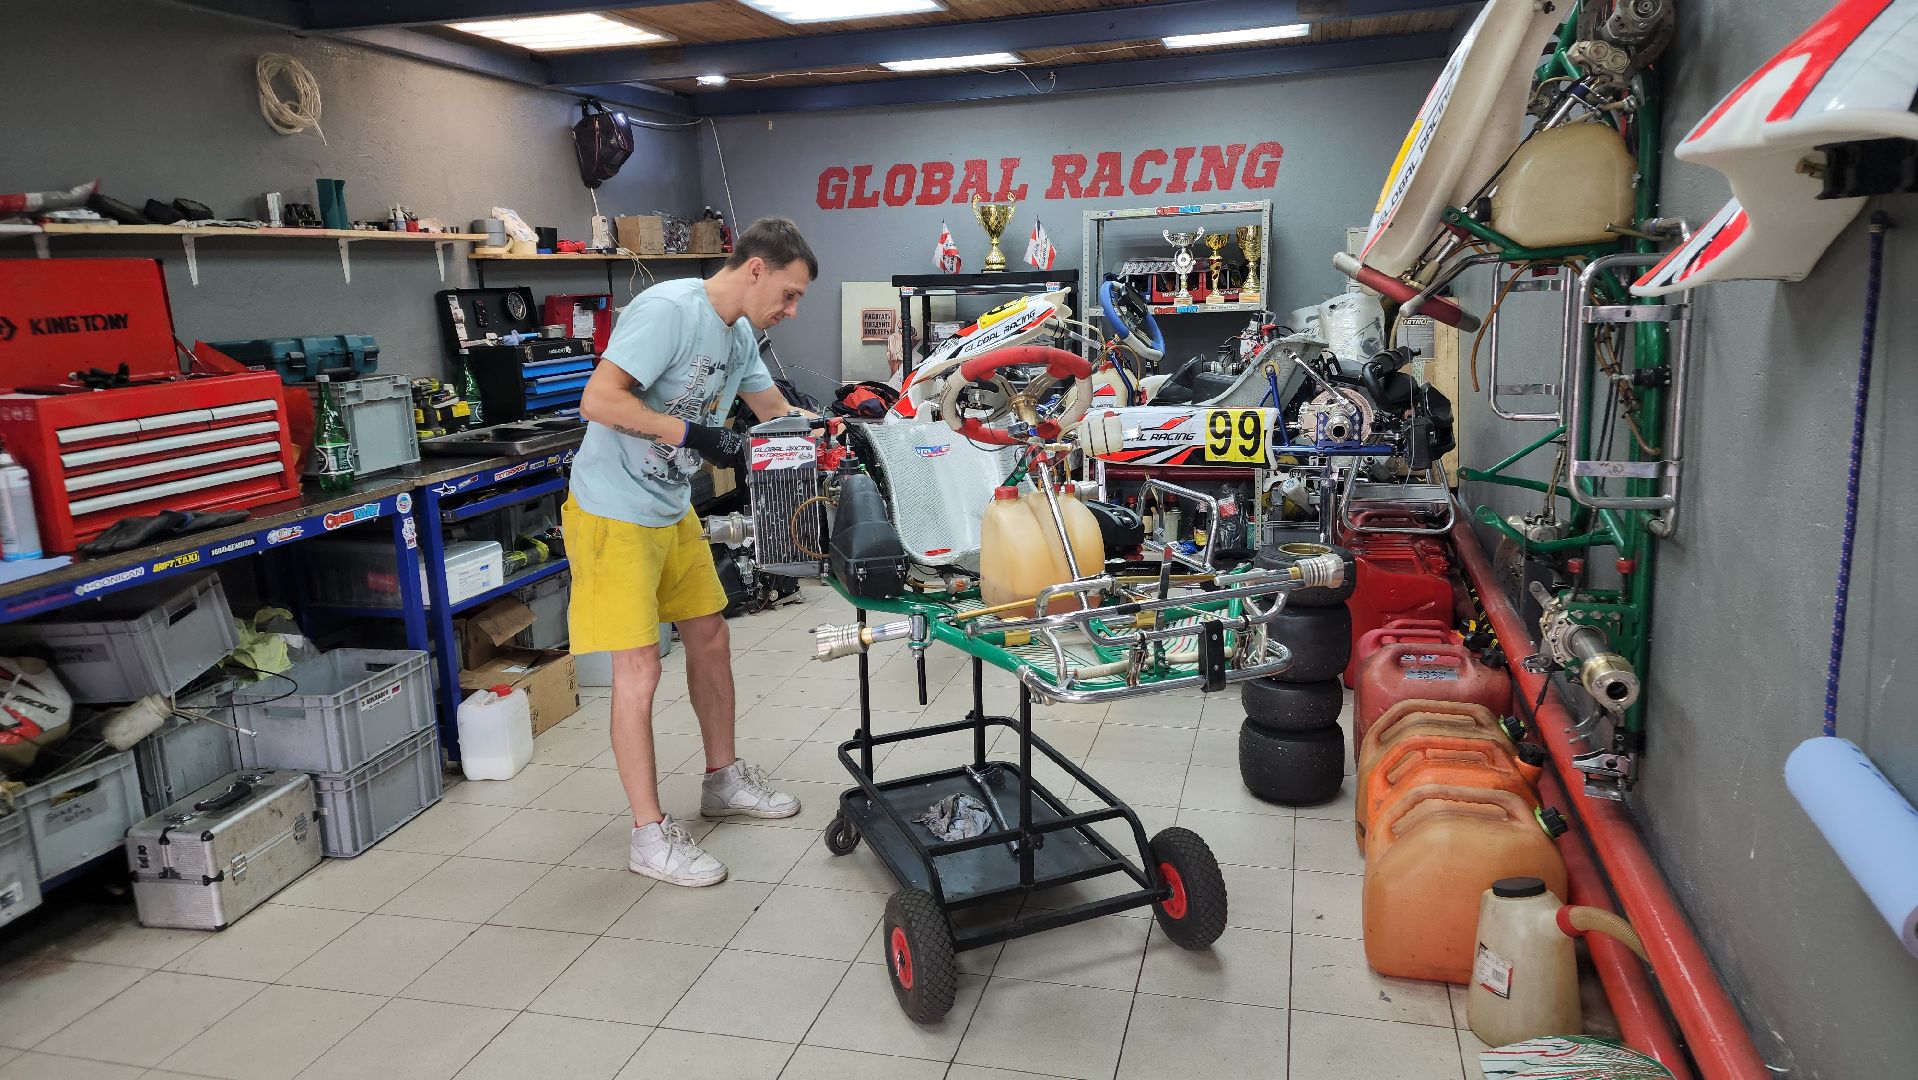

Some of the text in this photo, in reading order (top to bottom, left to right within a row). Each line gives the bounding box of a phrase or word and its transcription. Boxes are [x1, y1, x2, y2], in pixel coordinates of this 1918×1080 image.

[816, 140, 1284, 211] GLOBAL RACING
[30, 313, 129, 335] KING TONY
[964, 331, 1001, 353] GLOBAL
[1003, 308, 1036, 335] RACING
[1150, 432, 1197, 441] RACING
[1208, 410, 1261, 457] 99
[174, 552, 199, 568] TAXI
[84, 568, 143, 592] HOONIGAN
